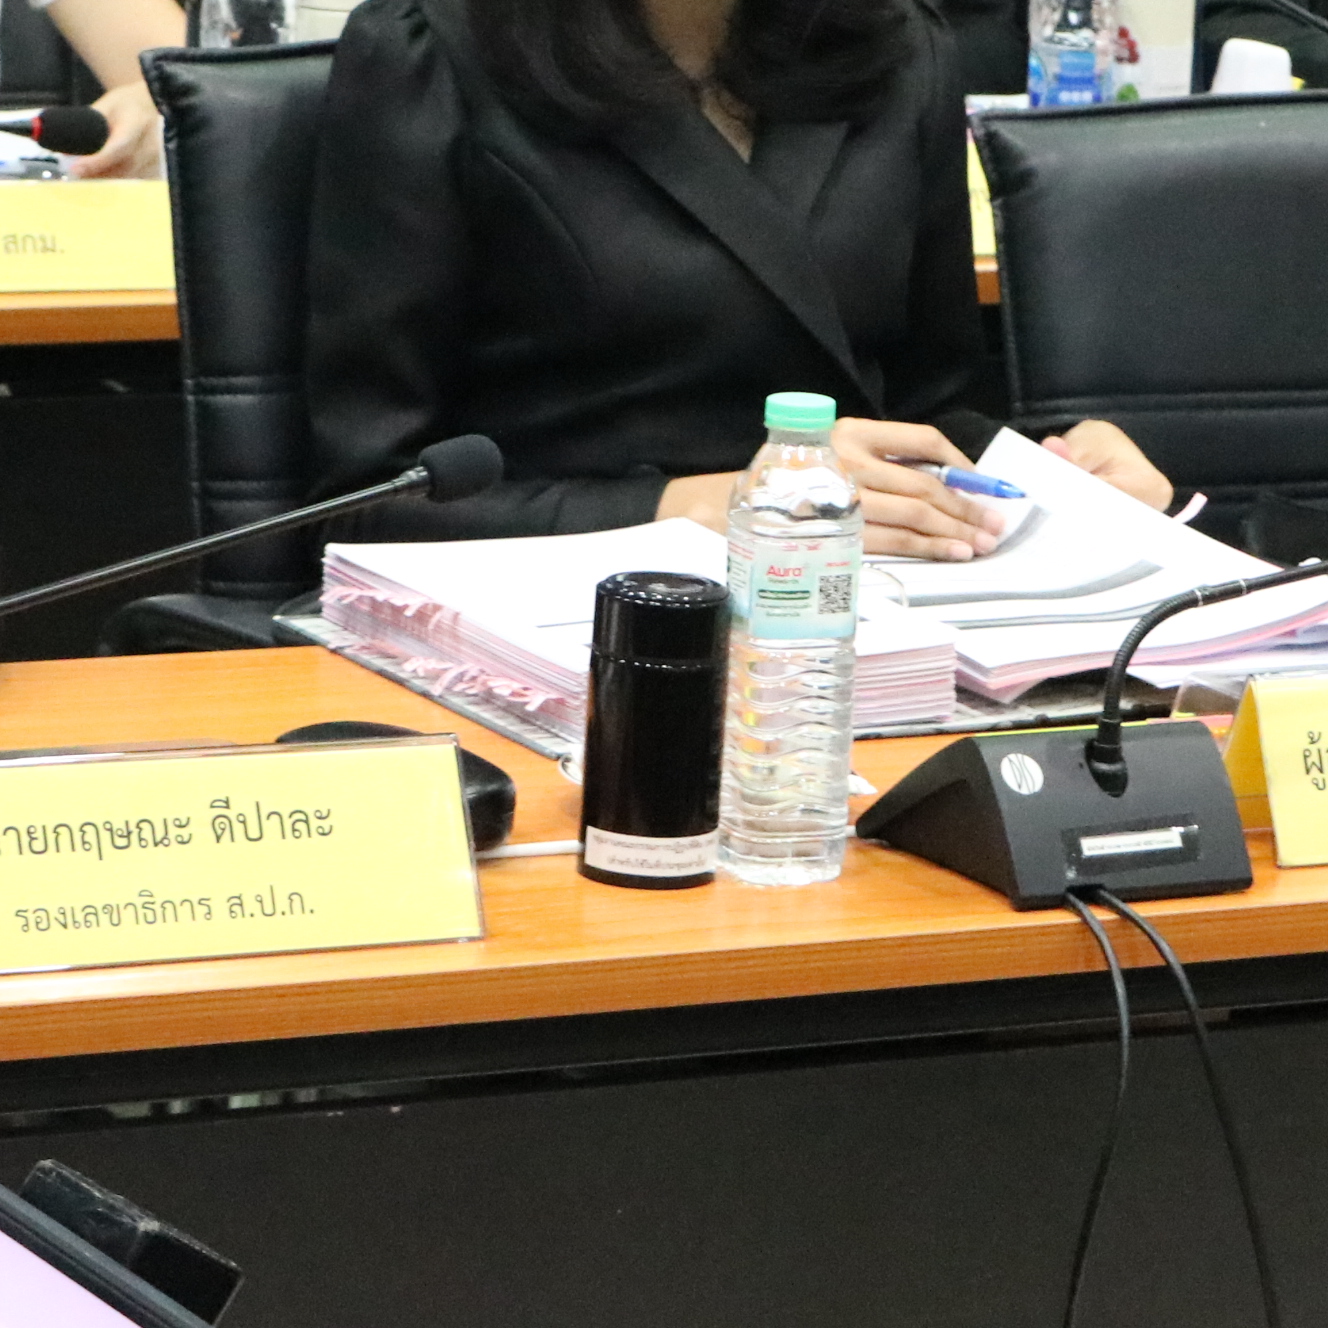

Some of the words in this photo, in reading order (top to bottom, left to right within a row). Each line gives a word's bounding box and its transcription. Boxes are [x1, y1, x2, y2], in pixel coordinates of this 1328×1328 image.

[767, 565, 803, 577] Aura
[209, 795, 335, 845] ดีปาละ
[14, 889, 213, 935] รองเลขาธิการ
[226, 884, 316, 921] ส.ป.ก.
